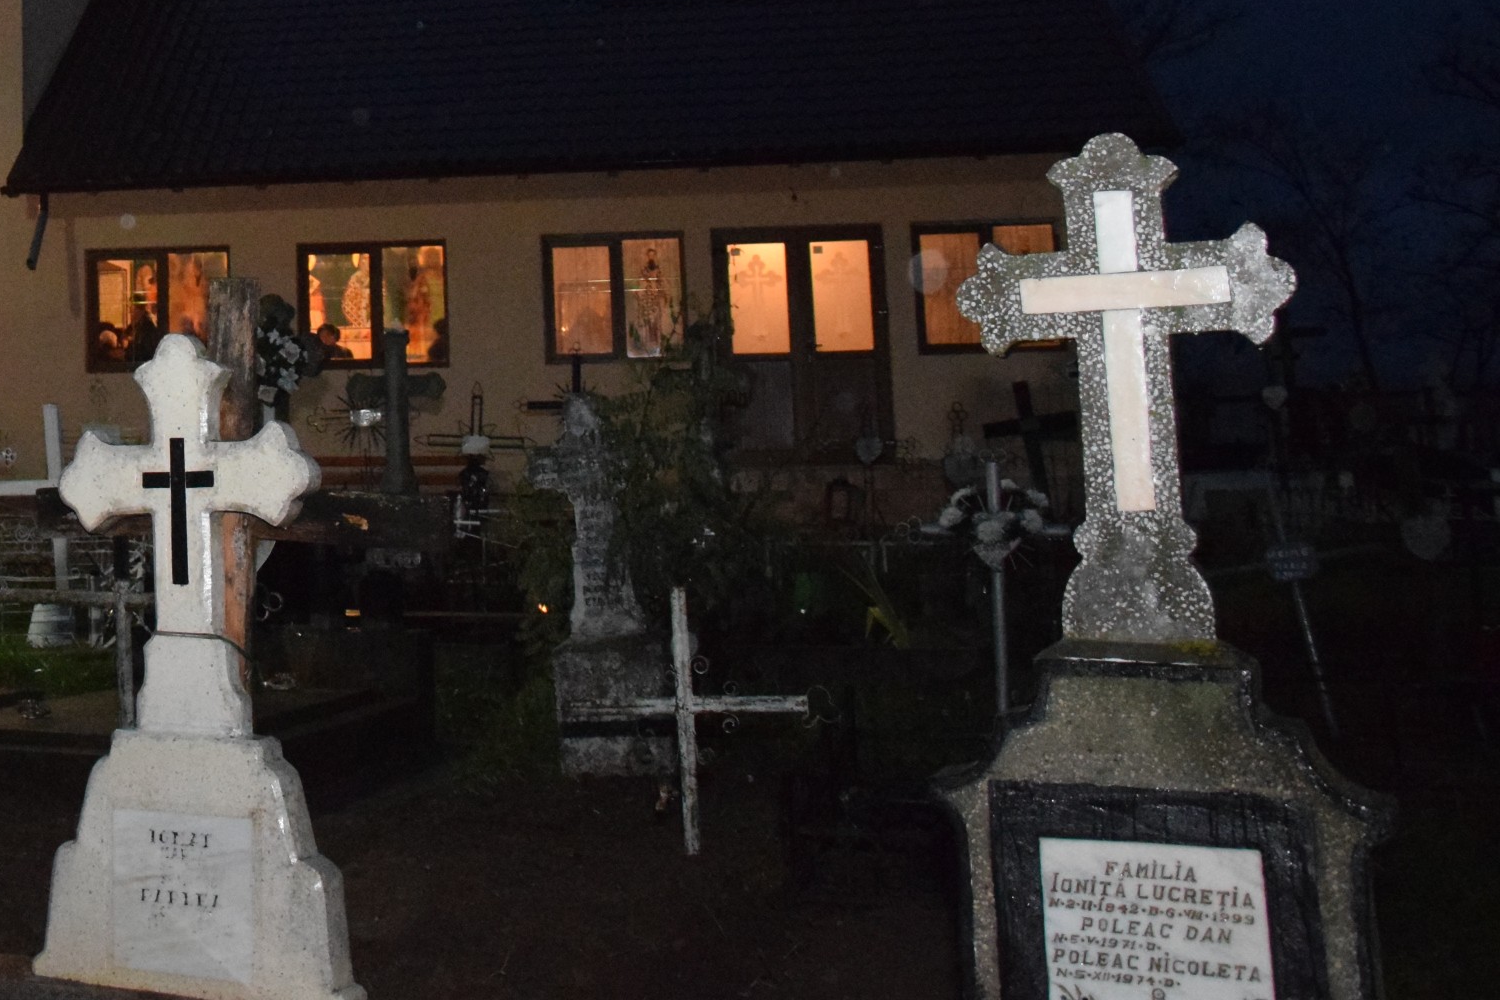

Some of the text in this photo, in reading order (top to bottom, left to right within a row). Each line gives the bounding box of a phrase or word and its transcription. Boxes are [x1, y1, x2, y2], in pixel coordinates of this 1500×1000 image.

[1080, 916, 1232, 944] POLEAC DAN
[1052, 948, 1140, 970] POLEAC
